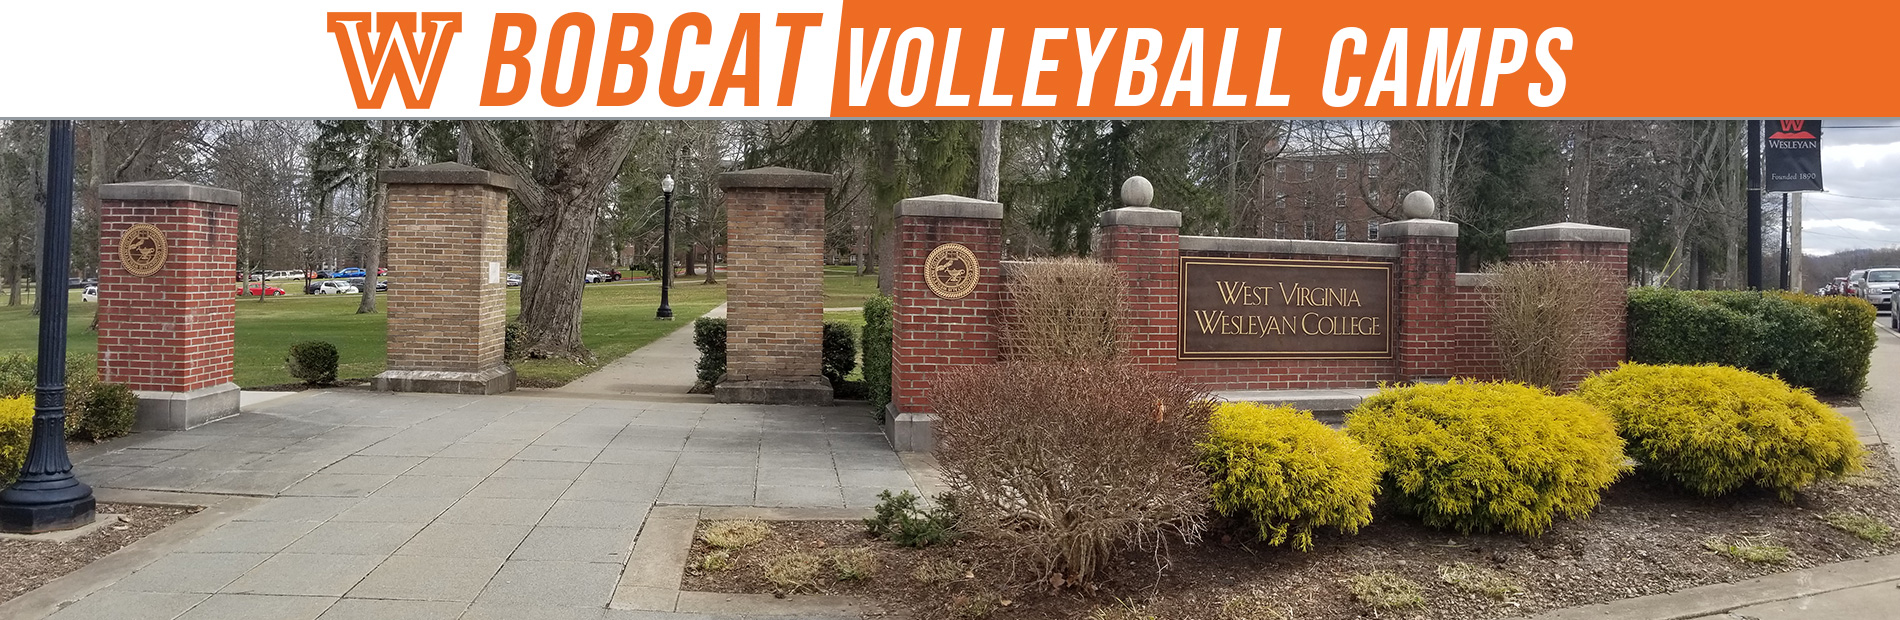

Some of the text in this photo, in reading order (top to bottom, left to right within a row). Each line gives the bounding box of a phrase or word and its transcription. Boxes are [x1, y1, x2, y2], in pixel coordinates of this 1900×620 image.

[1768, 140, 1817, 149] WESLEYAN
[1216, 281, 1361, 307] WEST VIRGINIA
[1194, 310, 1381, 338] WESLEYAN COLLEGE
